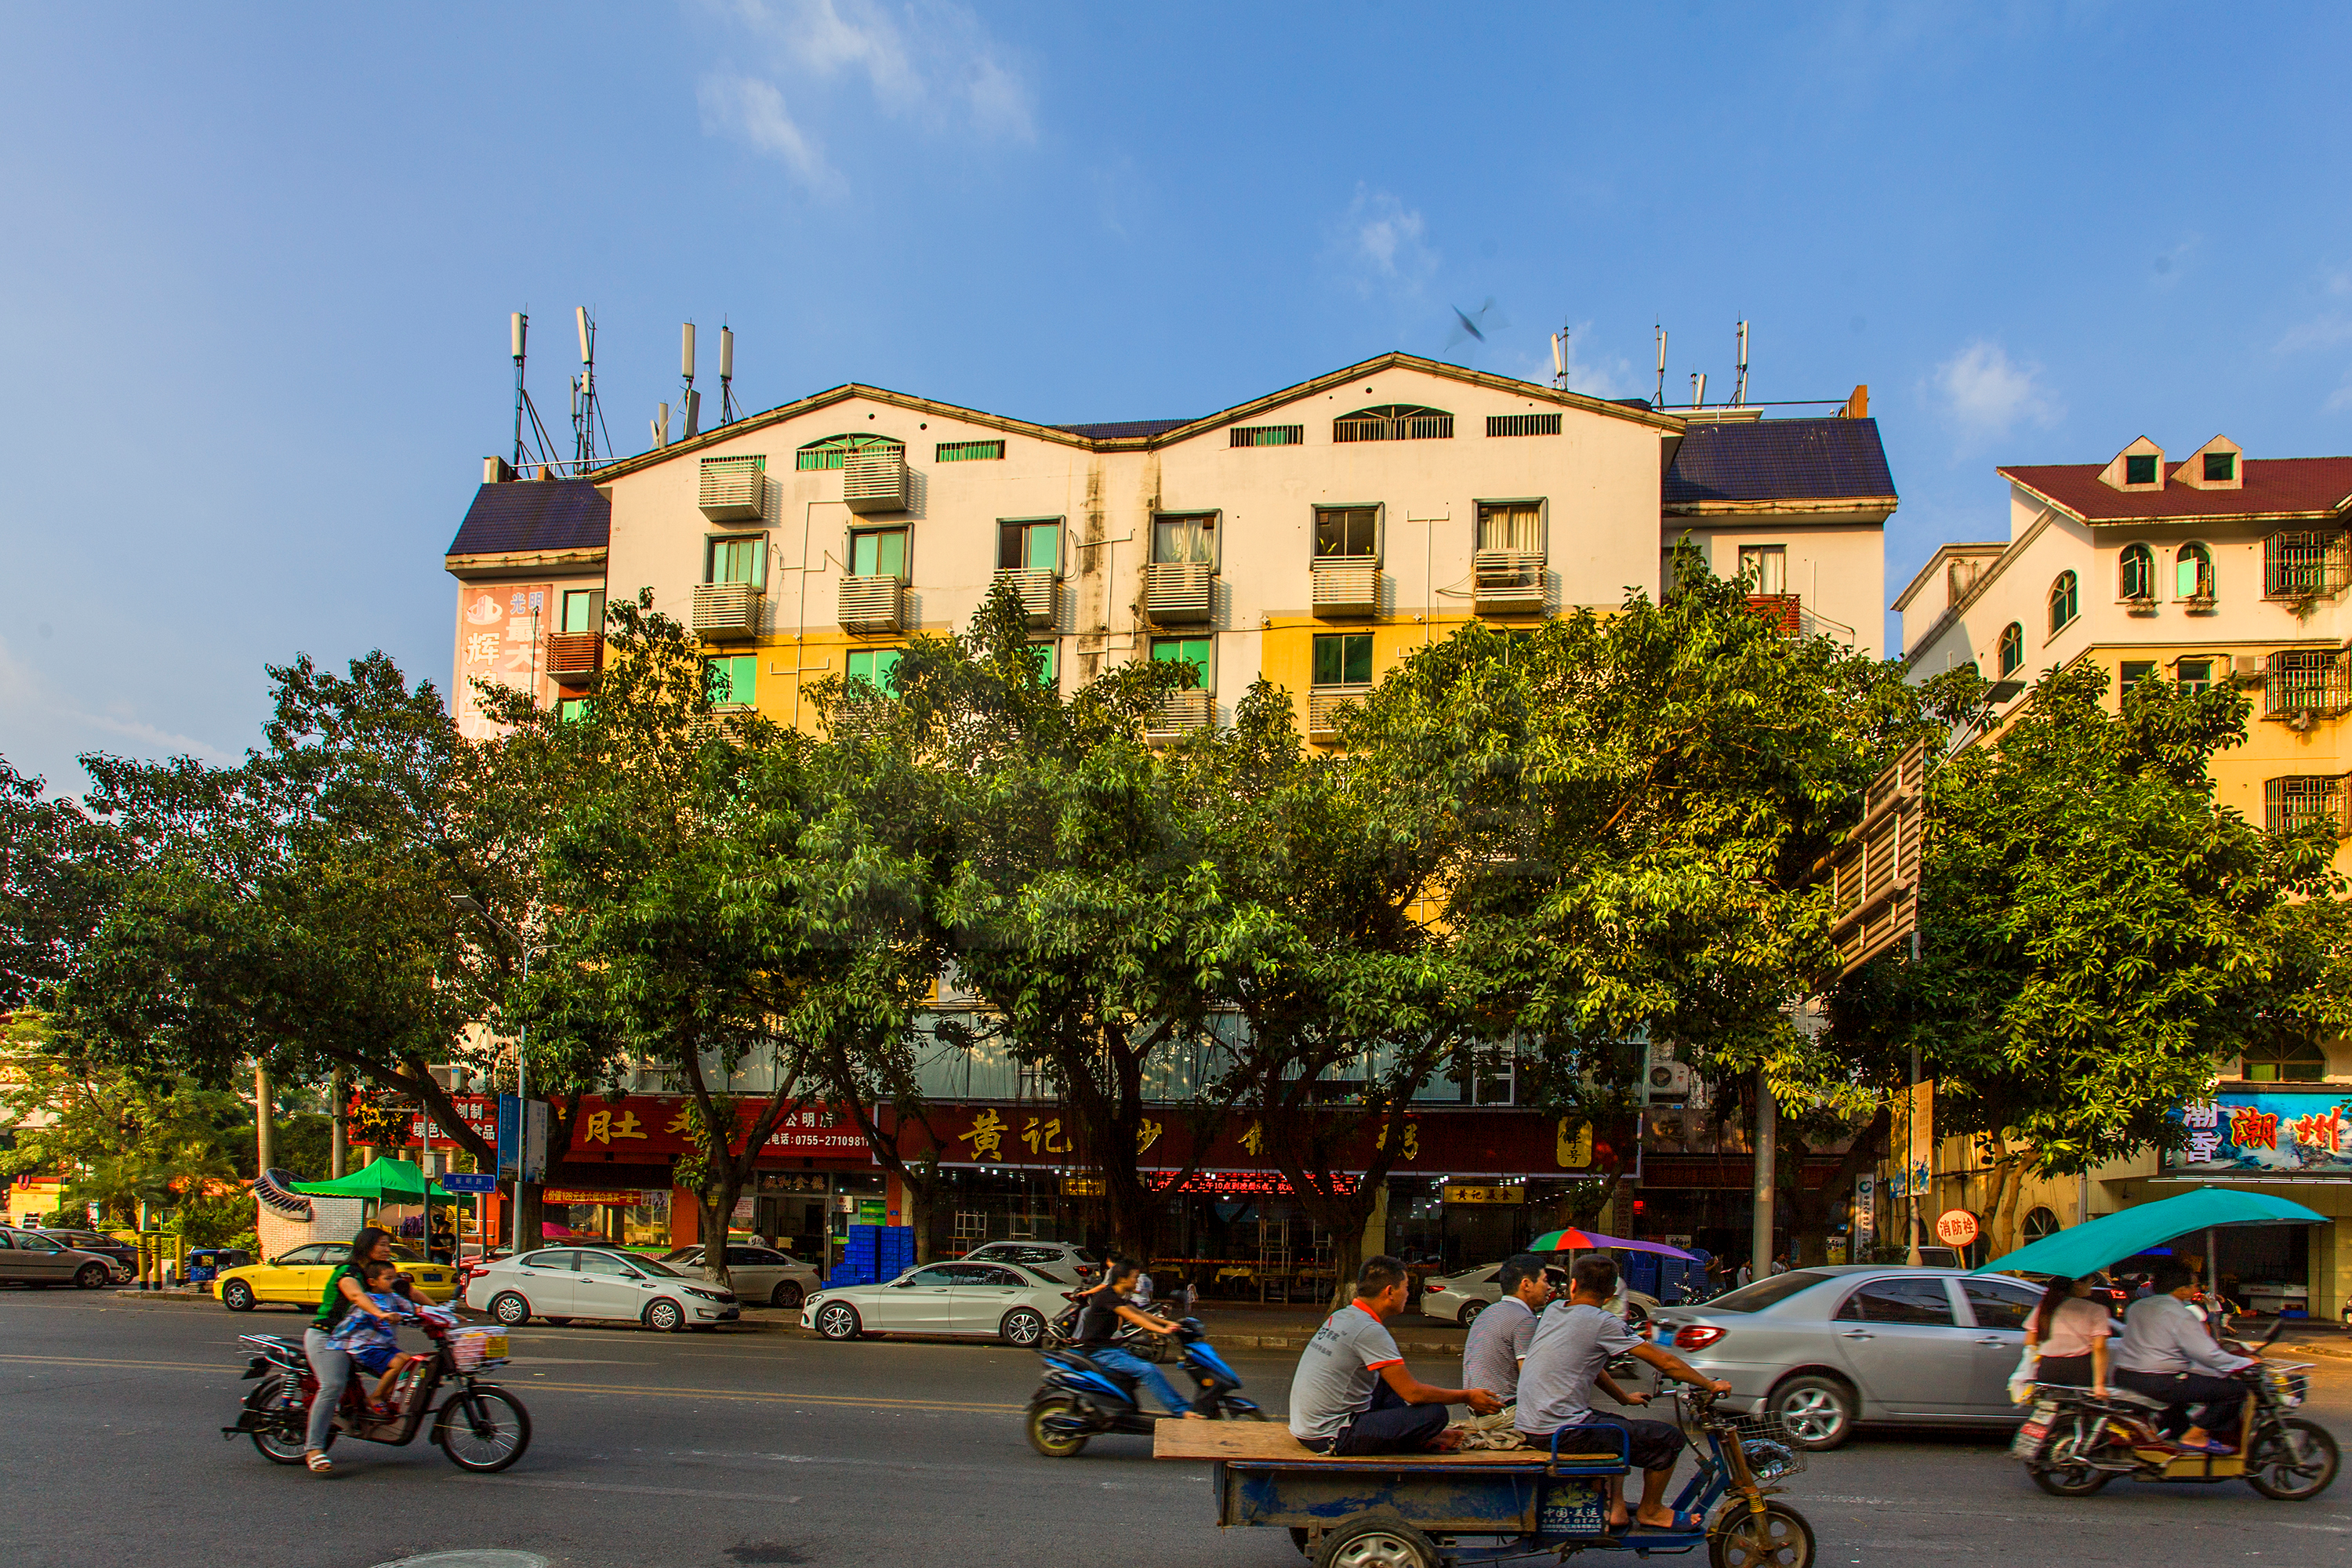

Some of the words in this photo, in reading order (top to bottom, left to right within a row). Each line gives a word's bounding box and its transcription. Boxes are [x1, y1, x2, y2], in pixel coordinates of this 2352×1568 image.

[510, 591, 544, 615] 光明
[764, 1133, 869, 1146] 电话:0755-2710981
[2231, 1106, 2344, 1152] 潮州
[1939, 1217, 1975, 1237] 消防栓
